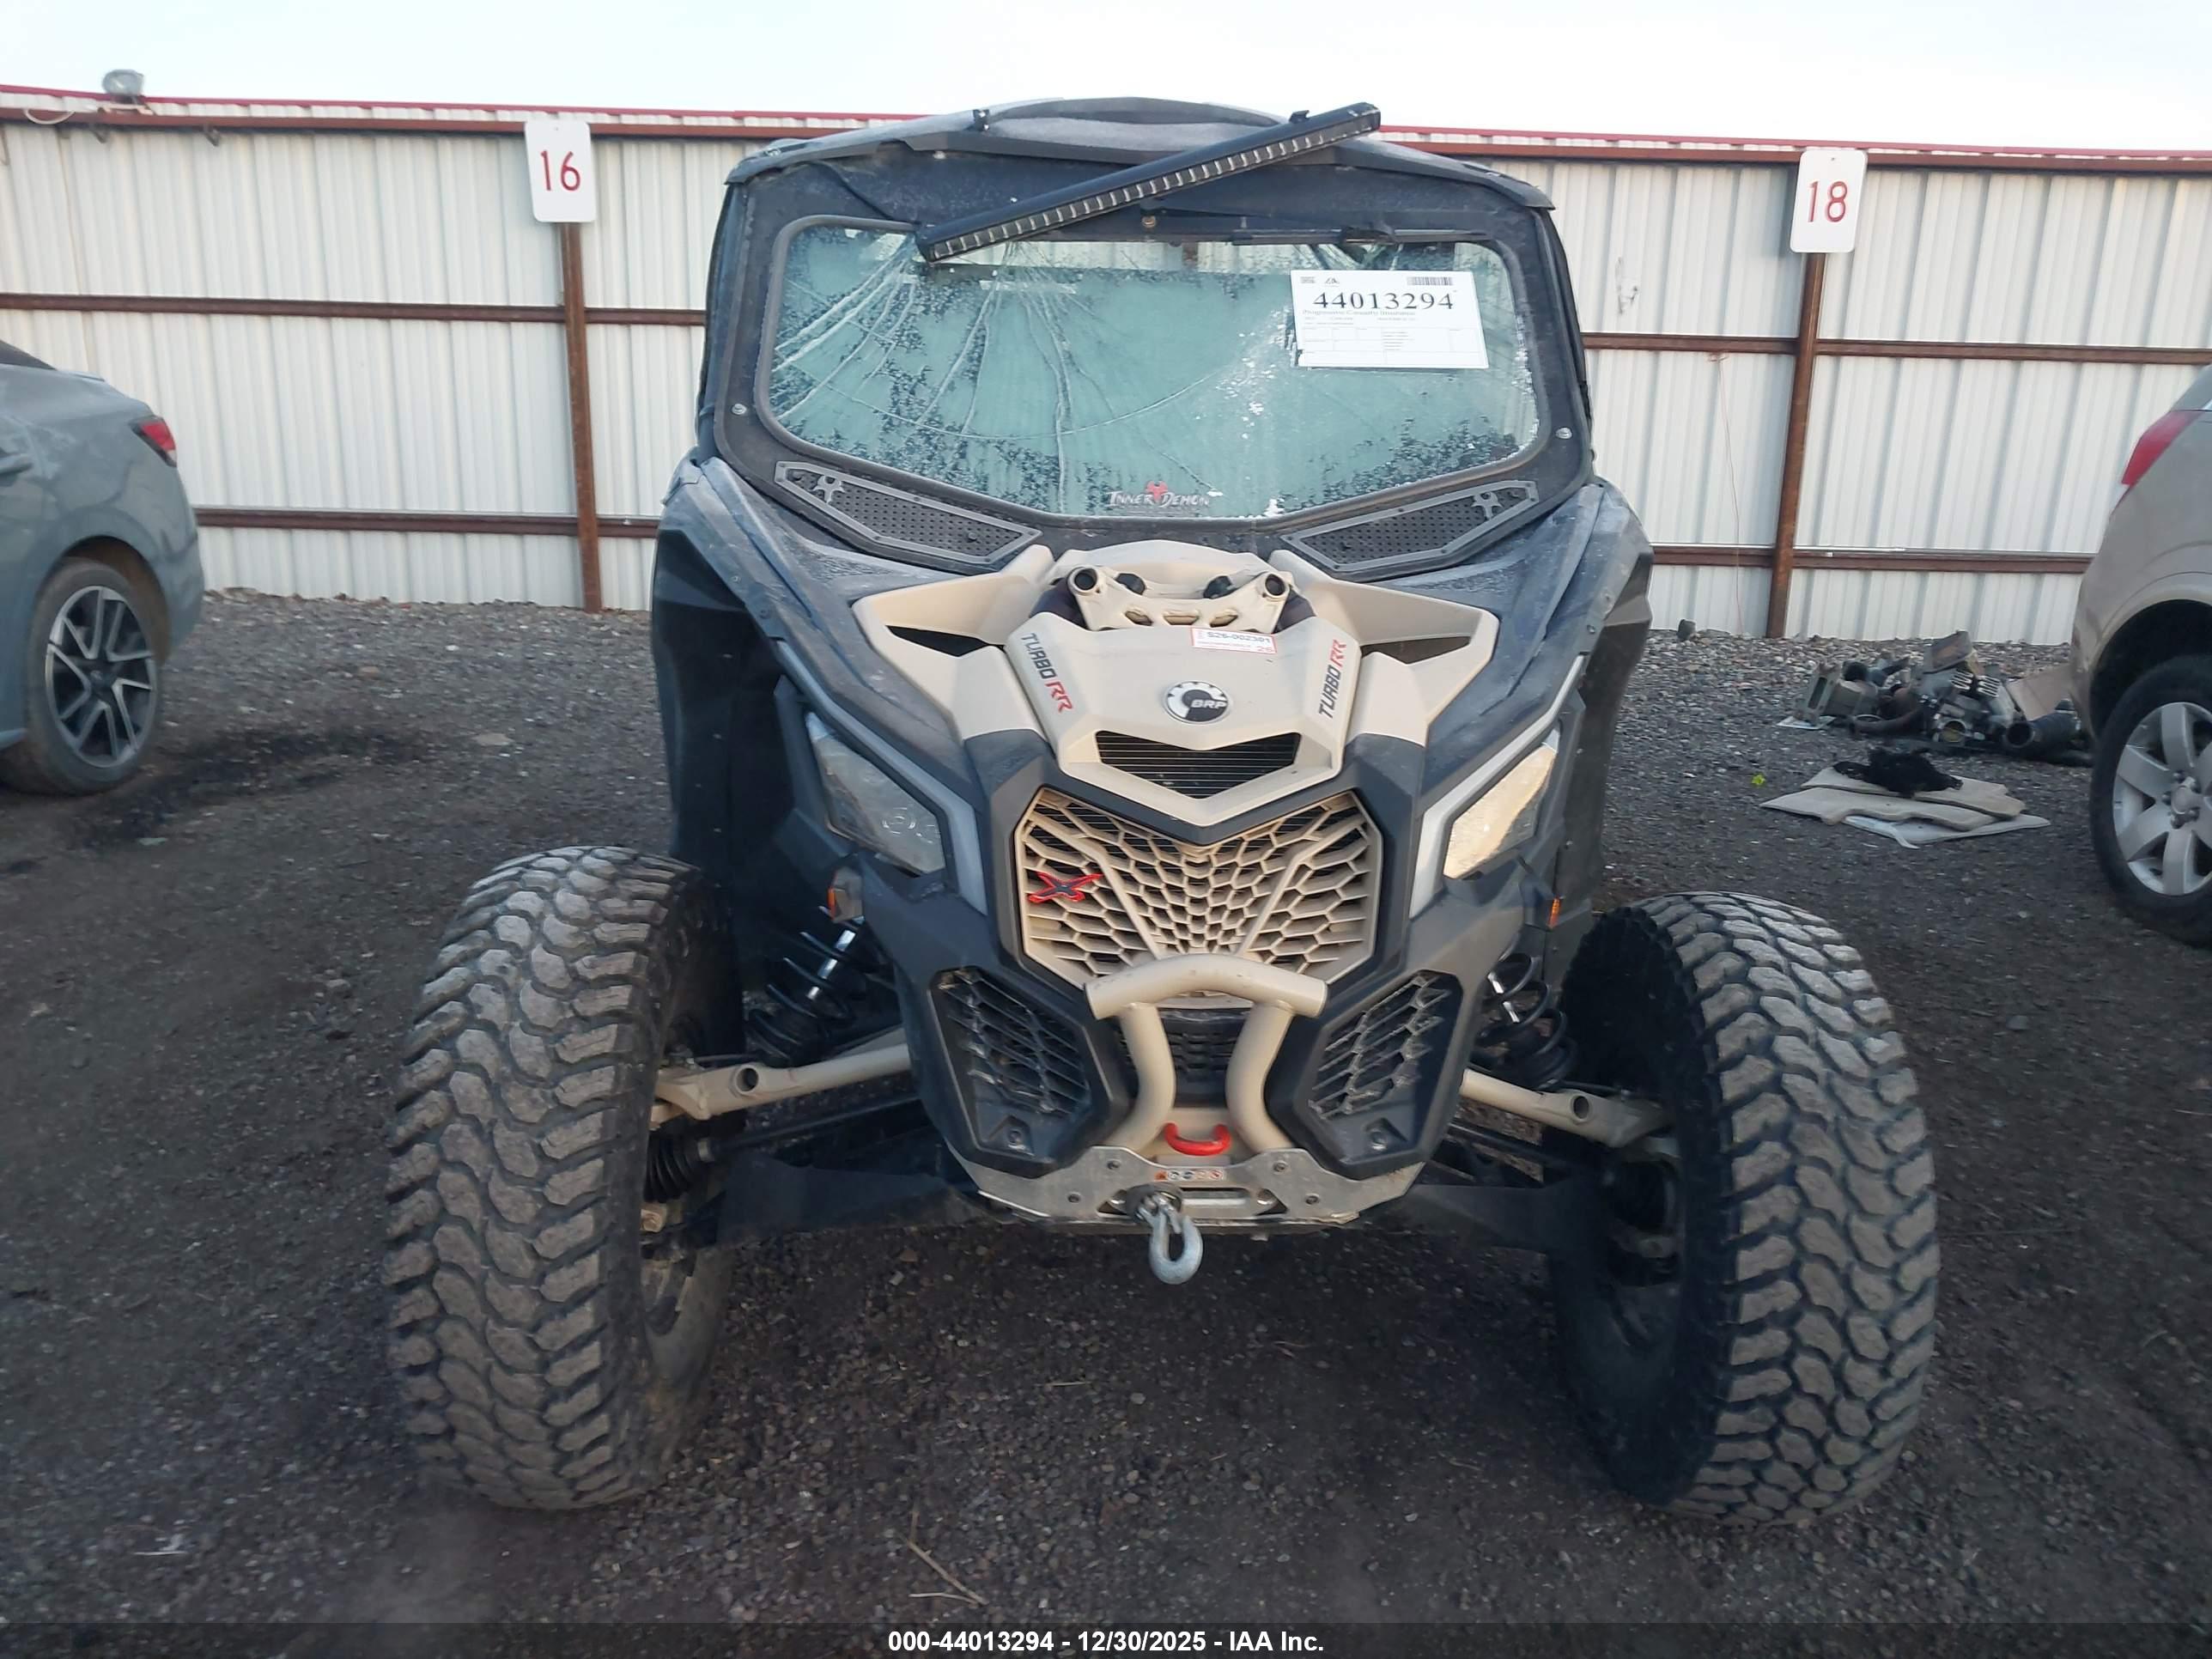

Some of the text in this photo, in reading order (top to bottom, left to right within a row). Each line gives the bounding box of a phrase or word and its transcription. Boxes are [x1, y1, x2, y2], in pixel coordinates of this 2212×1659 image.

[540, 149, 580, 191] 16
[1808, 180, 1848, 222] 18
[1312, 292, 1453, 310] 44013294
[1020, 632, 1073, 714] TURBO RR
[1318, 638, 1347, 720] TURBO RR
[1190, 698, 1227, 709] BRP
